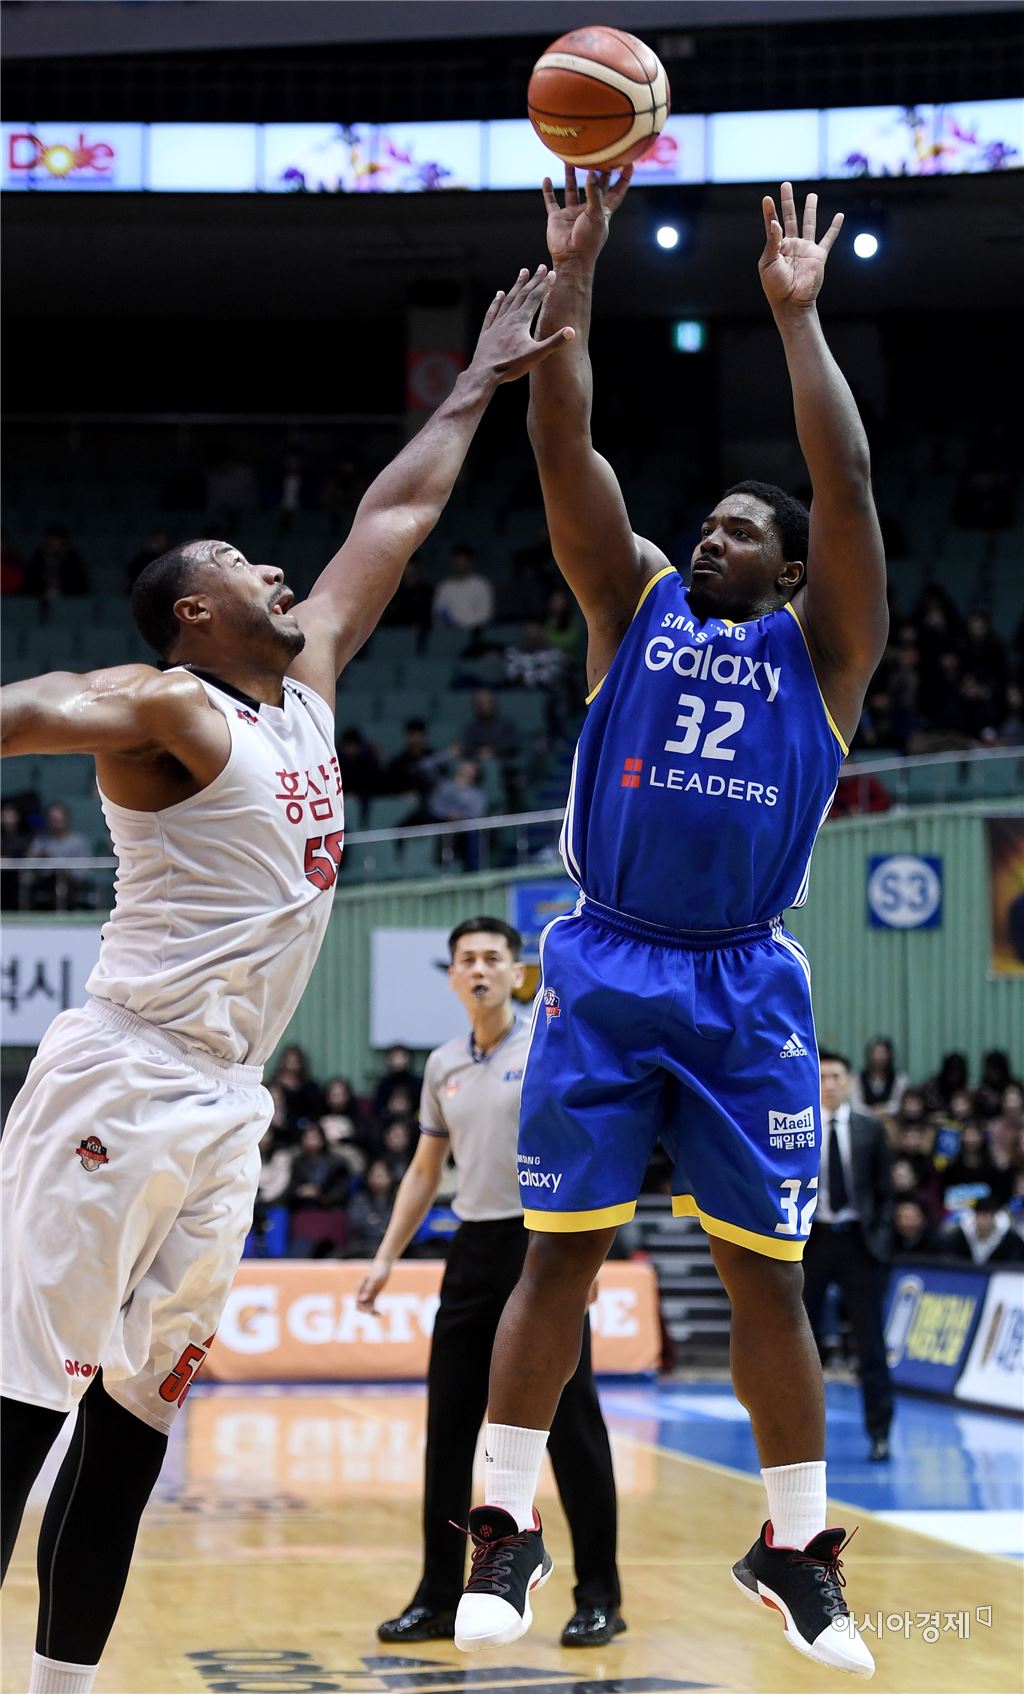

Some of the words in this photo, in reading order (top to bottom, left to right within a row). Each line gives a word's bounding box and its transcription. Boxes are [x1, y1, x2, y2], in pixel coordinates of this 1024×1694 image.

[9, 132, 114, 177] Dole
[644, 635, 782, 703] Galaxy
[664, 693, 746, 762] 32
[649, 765, 779, 807] LEADERS
[879, 871, 930, 913] S3
[779, 1048, 808, 1060] adidas
[769, 1131, 815, 1150] 매일유업
[773, 1113, 812, 1131] Maeil
[517, 1168, 563, 1194] alaxy
